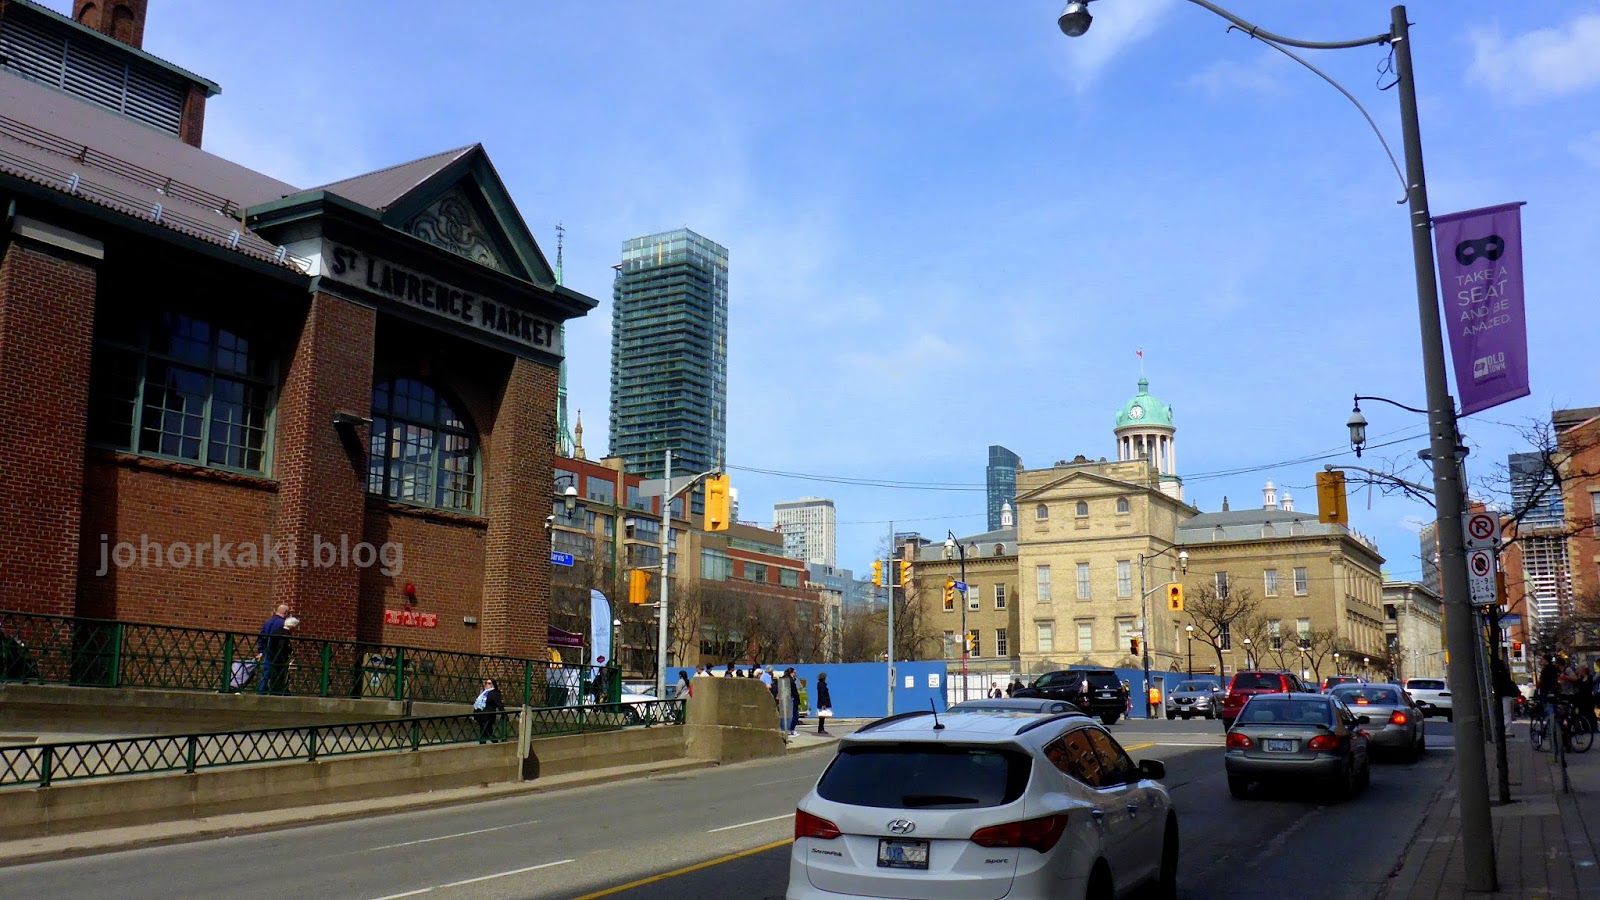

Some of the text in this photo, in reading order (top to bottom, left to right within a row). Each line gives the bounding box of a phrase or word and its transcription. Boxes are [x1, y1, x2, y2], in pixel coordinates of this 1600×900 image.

[1455, 266, 1508, 286] TAKE A
[366, 258, 475, 323] LAWRENCE
[482, 299, 556, 348] MARKET
[1457, 279, 1508, 307] SEAT
[1460, 298, 1510, 322] AND BE
[1487, 352, 1505, 366] OLD
[1488, 362, 1506, 373] TOWN
